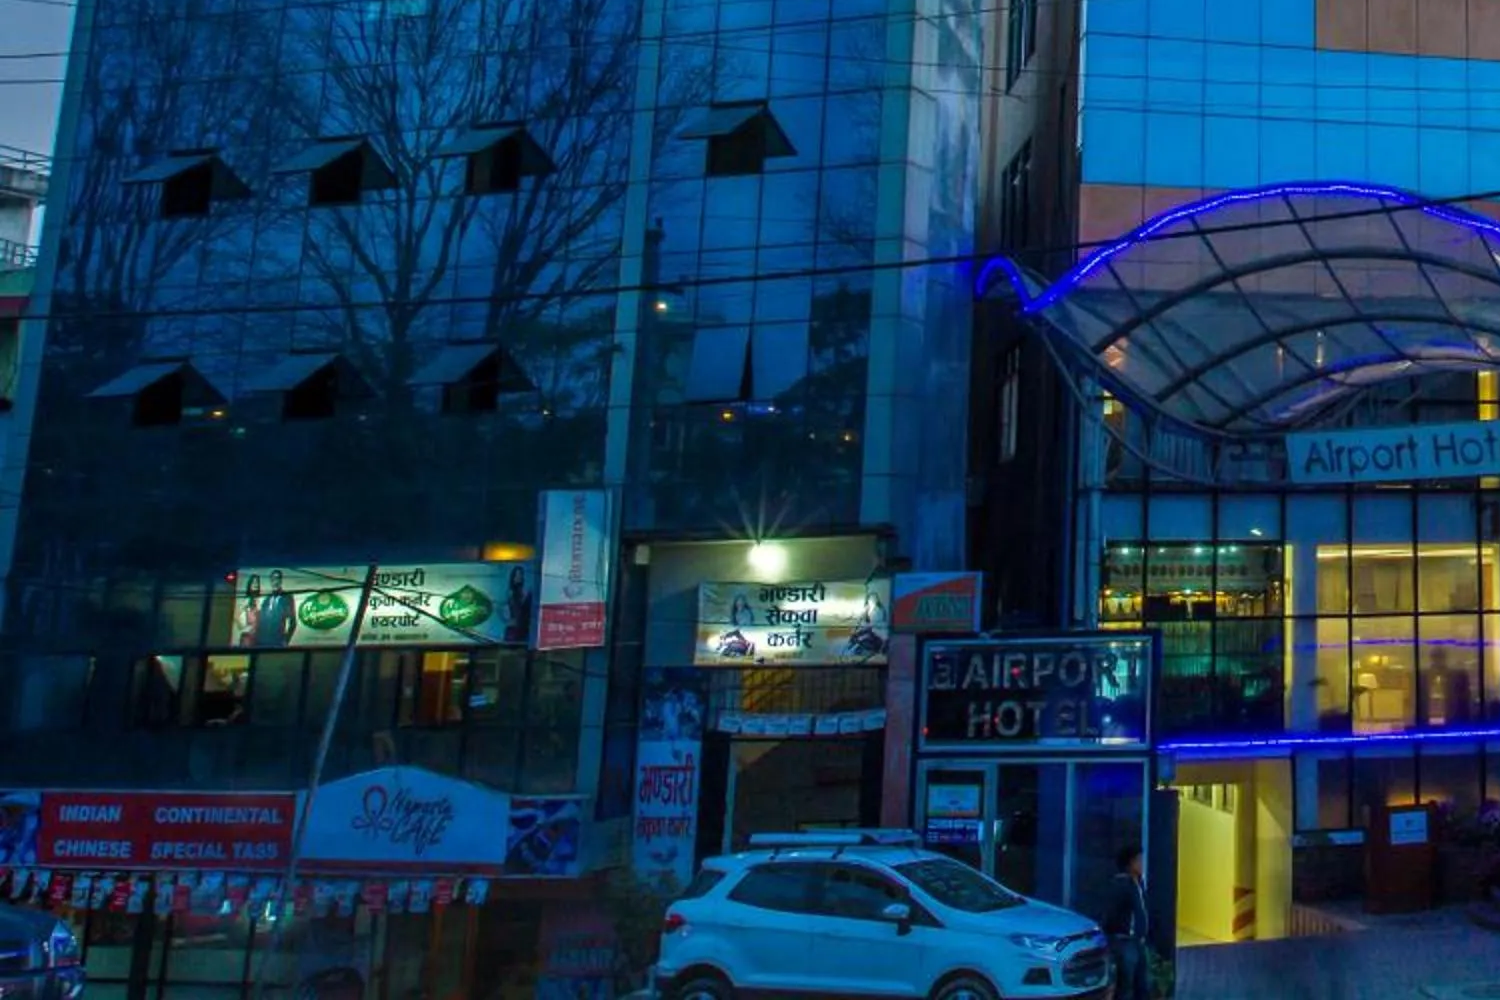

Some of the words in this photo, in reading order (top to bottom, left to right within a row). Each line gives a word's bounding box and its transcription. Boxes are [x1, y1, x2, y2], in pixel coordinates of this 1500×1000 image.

[962, 650, 1141, 690] AIRPORT
[967, 698, 1100, 738] HOTEL
[58, 804, 121, 823] INDIAN
[154, 806, 282, 825] CONTINENTAL
[53, 839, 132, 859] CHINESE
[150, 841, 226, 860] SPECIAL
